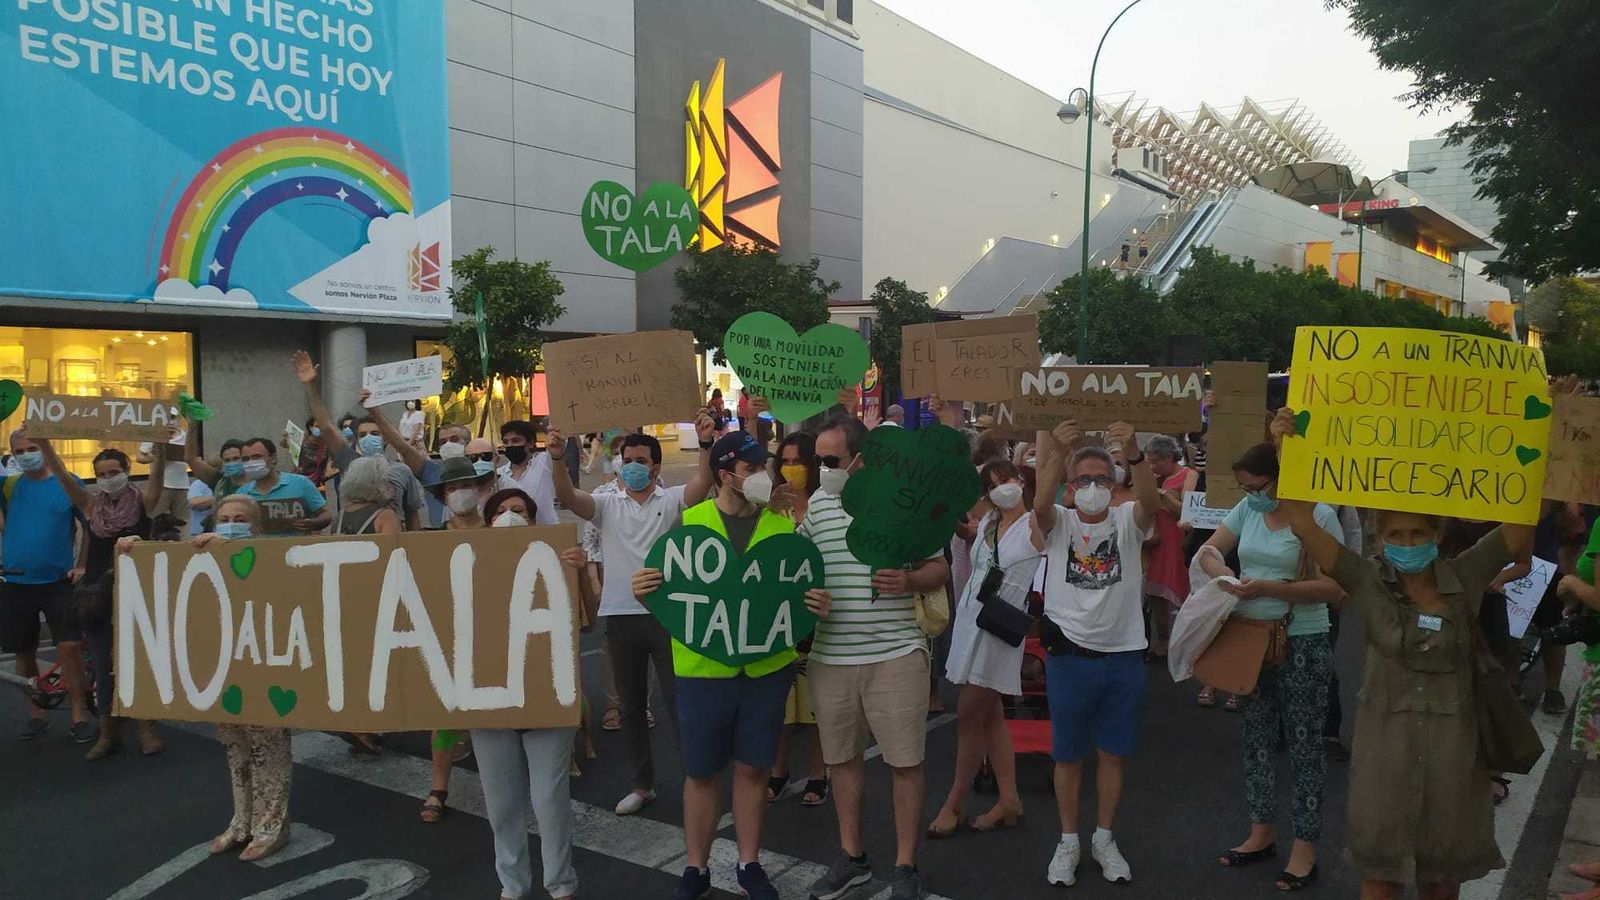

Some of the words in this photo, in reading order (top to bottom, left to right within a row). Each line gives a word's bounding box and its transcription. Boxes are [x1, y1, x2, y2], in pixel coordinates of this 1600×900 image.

[246, 0, 373, 53] HECHO
[19, 24, 236, 102] ESTEMOS
[246, 79, 340, 123] AQUÍ
[230, 31, 310, 78] QUE
[321, 53, 393, 96] HOY
[590, 191, 632, 223] NO
[643, 202, 660, 217] A
[666, 200, 692, 223] LA
[1368, 199, 1399, 210] KING
[594, 223, 684, 256] TALA
[324, 290, 349, 298] somos
[350, 291, 378, 300] Nervión
[379, 293, 398, 301] Plaza
[729, 331, 750, 346] POR
[913, 340, 936, 363] EL
[950, 338, 1028, 361] TALADOR
[1309, 329, 1360, 362] NO
[1372, 341, 1392, 360] A
[1404, 342, 1430, 361] UN
[737, 365, 752, 379] NO
[754, 370, 760, 380] A
[762, 371, 776, 384] LA
[753, 352, 836, 374] SOSTENIBLE
[750, 384, 768, 398] DEL
[1020, 369, 1070, 397] NO
[1134, 371, 1202, 400] TALA
[1301, 366, 1524, 417] INSOSTENIBLE
[26, 397, 66, 423] NO
[70, 408, 80, 418] A
[82, 407, 100, 418] LA
[103, 400, 169, 427] TALA
[1325, 415, 1514, 457] INSOLIDARIO
[1311, 451, 1528, 505] INNECESARIO
[650, 536, 727, 584] NO
[742, 561, 761, 583] A
[779, 558, 813, 582] LA
[118, 551, 233, 712] NO
[285, 540, 577, 713] TALA
[668, 592, 794, 656] TALA
